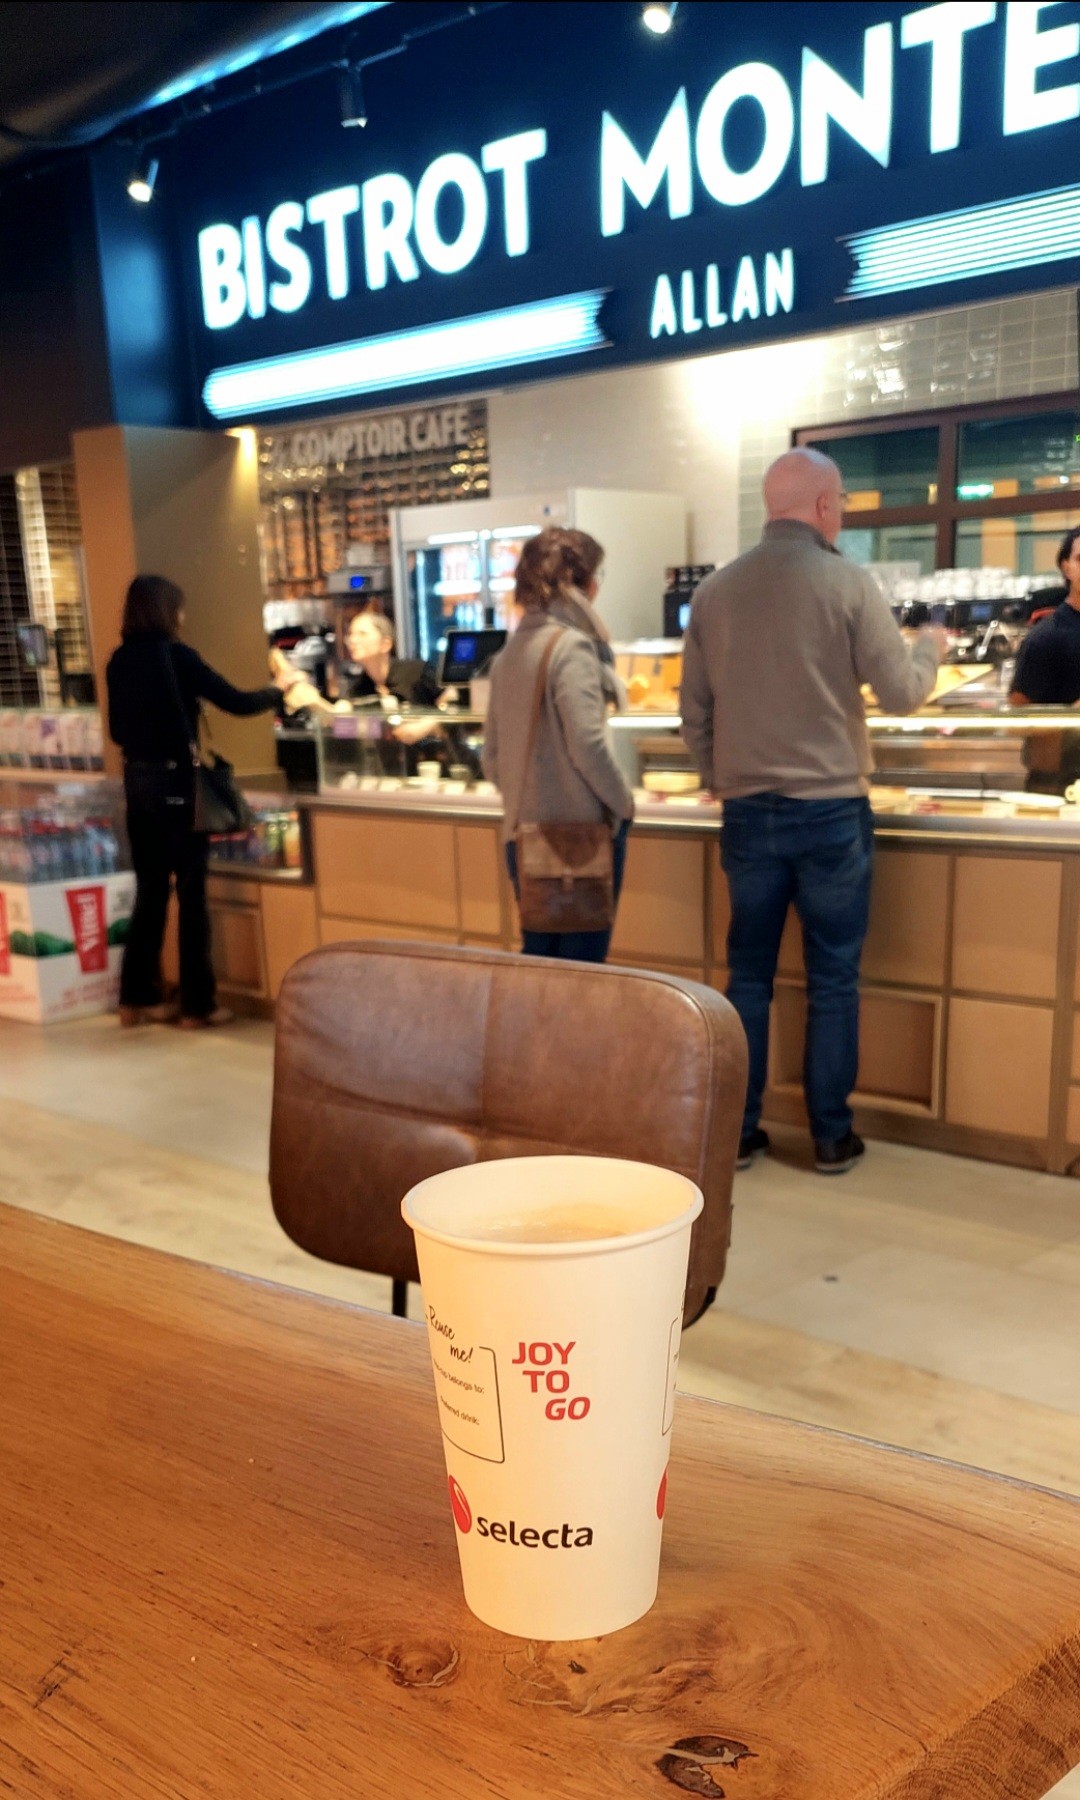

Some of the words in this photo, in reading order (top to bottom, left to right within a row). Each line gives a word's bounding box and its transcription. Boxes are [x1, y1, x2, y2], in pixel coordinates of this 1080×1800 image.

[198, 128, 547, 330] BISTROT
[650, 247, 795, 339] ALLAN
[291, 415, 406, 465] COMPTOIR
[450, 1344, 474, 1364] me!
[512, 1341, 577, 1365] JOY
[522, 1370, 570, 1393] TO
[545, 1397, 591, 1420] GO
[476, 1516, 594, 1549] selecta
